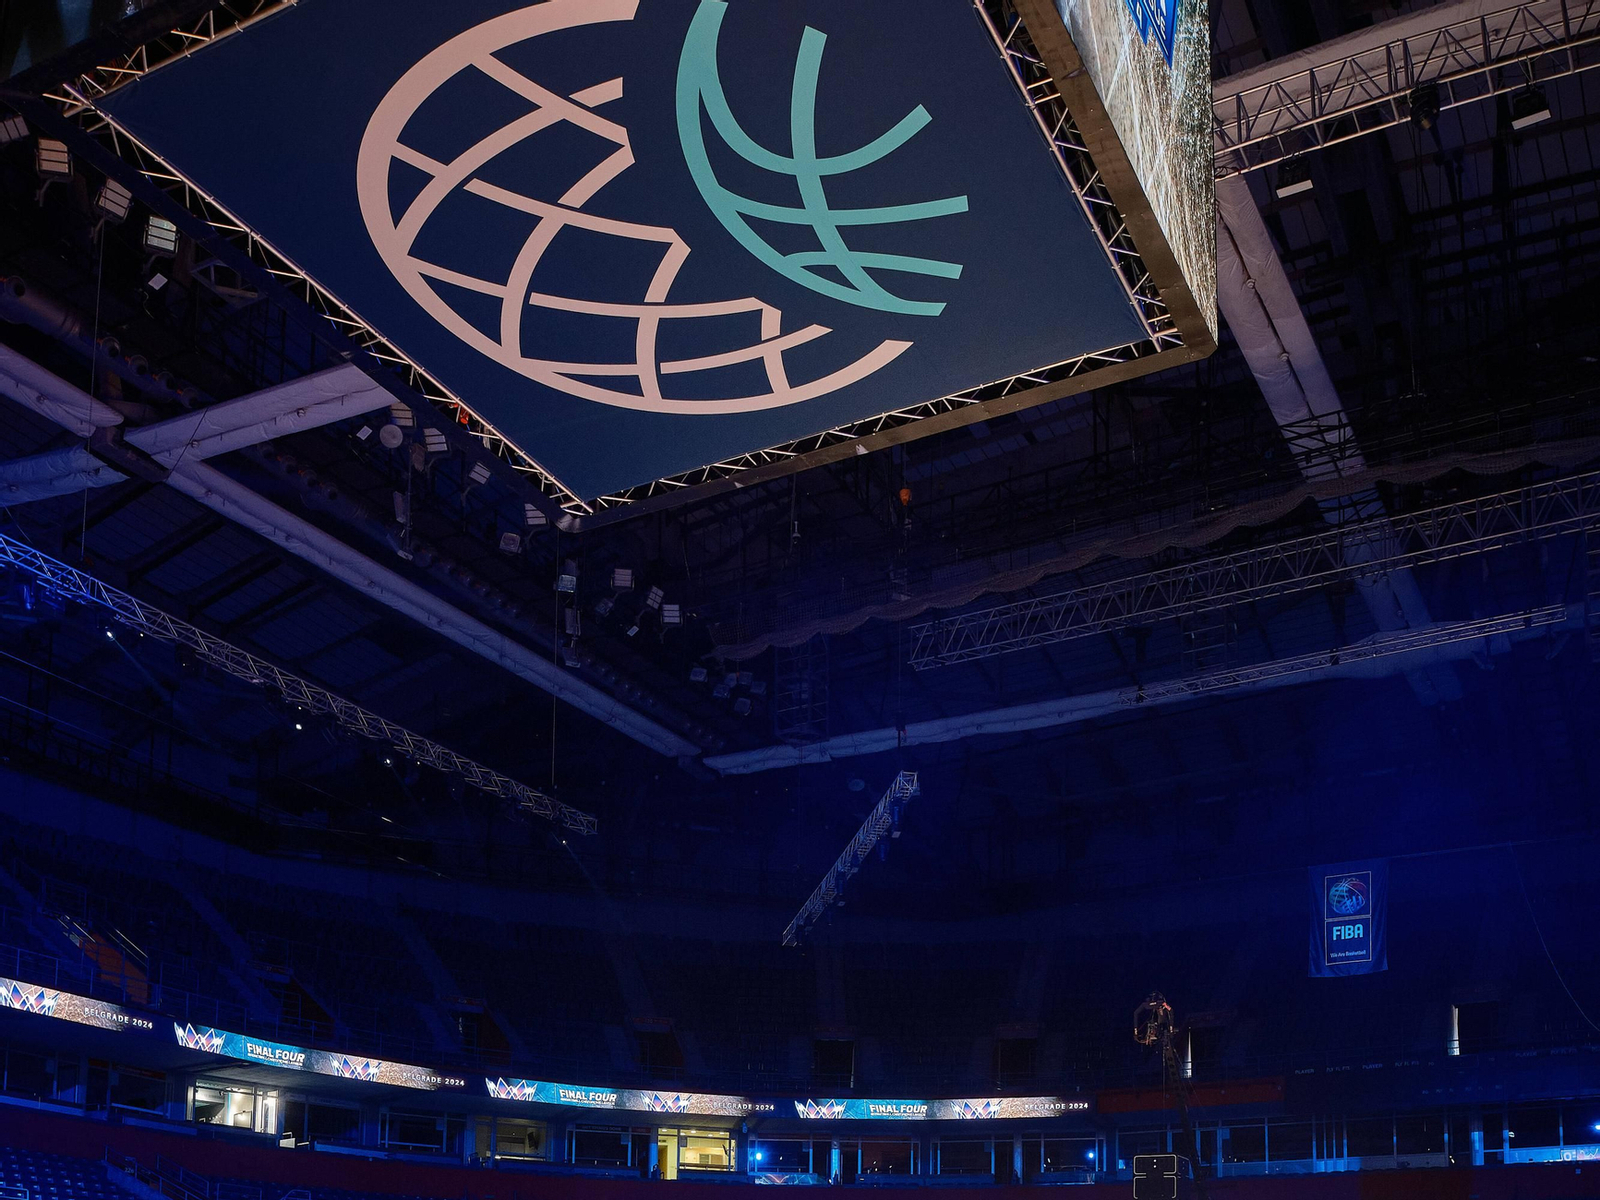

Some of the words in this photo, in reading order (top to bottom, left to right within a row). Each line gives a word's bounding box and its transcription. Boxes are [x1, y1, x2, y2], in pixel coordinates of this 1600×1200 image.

[1333, 924, 1363, 940] FIBA
[84, 1007, 129, 1023] BELGRADE
[133, 1018, 153, 1030] 2024
[246, 1043, 275, 1058] FINAL
[275, 1049, 305, 1063] FOUR
[402, 1072, 442, 1084] BELGRADE
[445, 1078, 465, 1086] 2024
[559, 1089, 588, 1101] FINAL
[588, 1092, 617, 1102] FOUR
[713, 1102, 752, 1111] BELGRADE
[755, 1103, 775, 1111] 2024
[869, 1104, 900, 1113] FINAL
[900, 1104, 927, 1113] FOUR
[1024, 1102, 1066, 1110] BELGRADE
[1069, 1102, 1089, 1110] 2024
